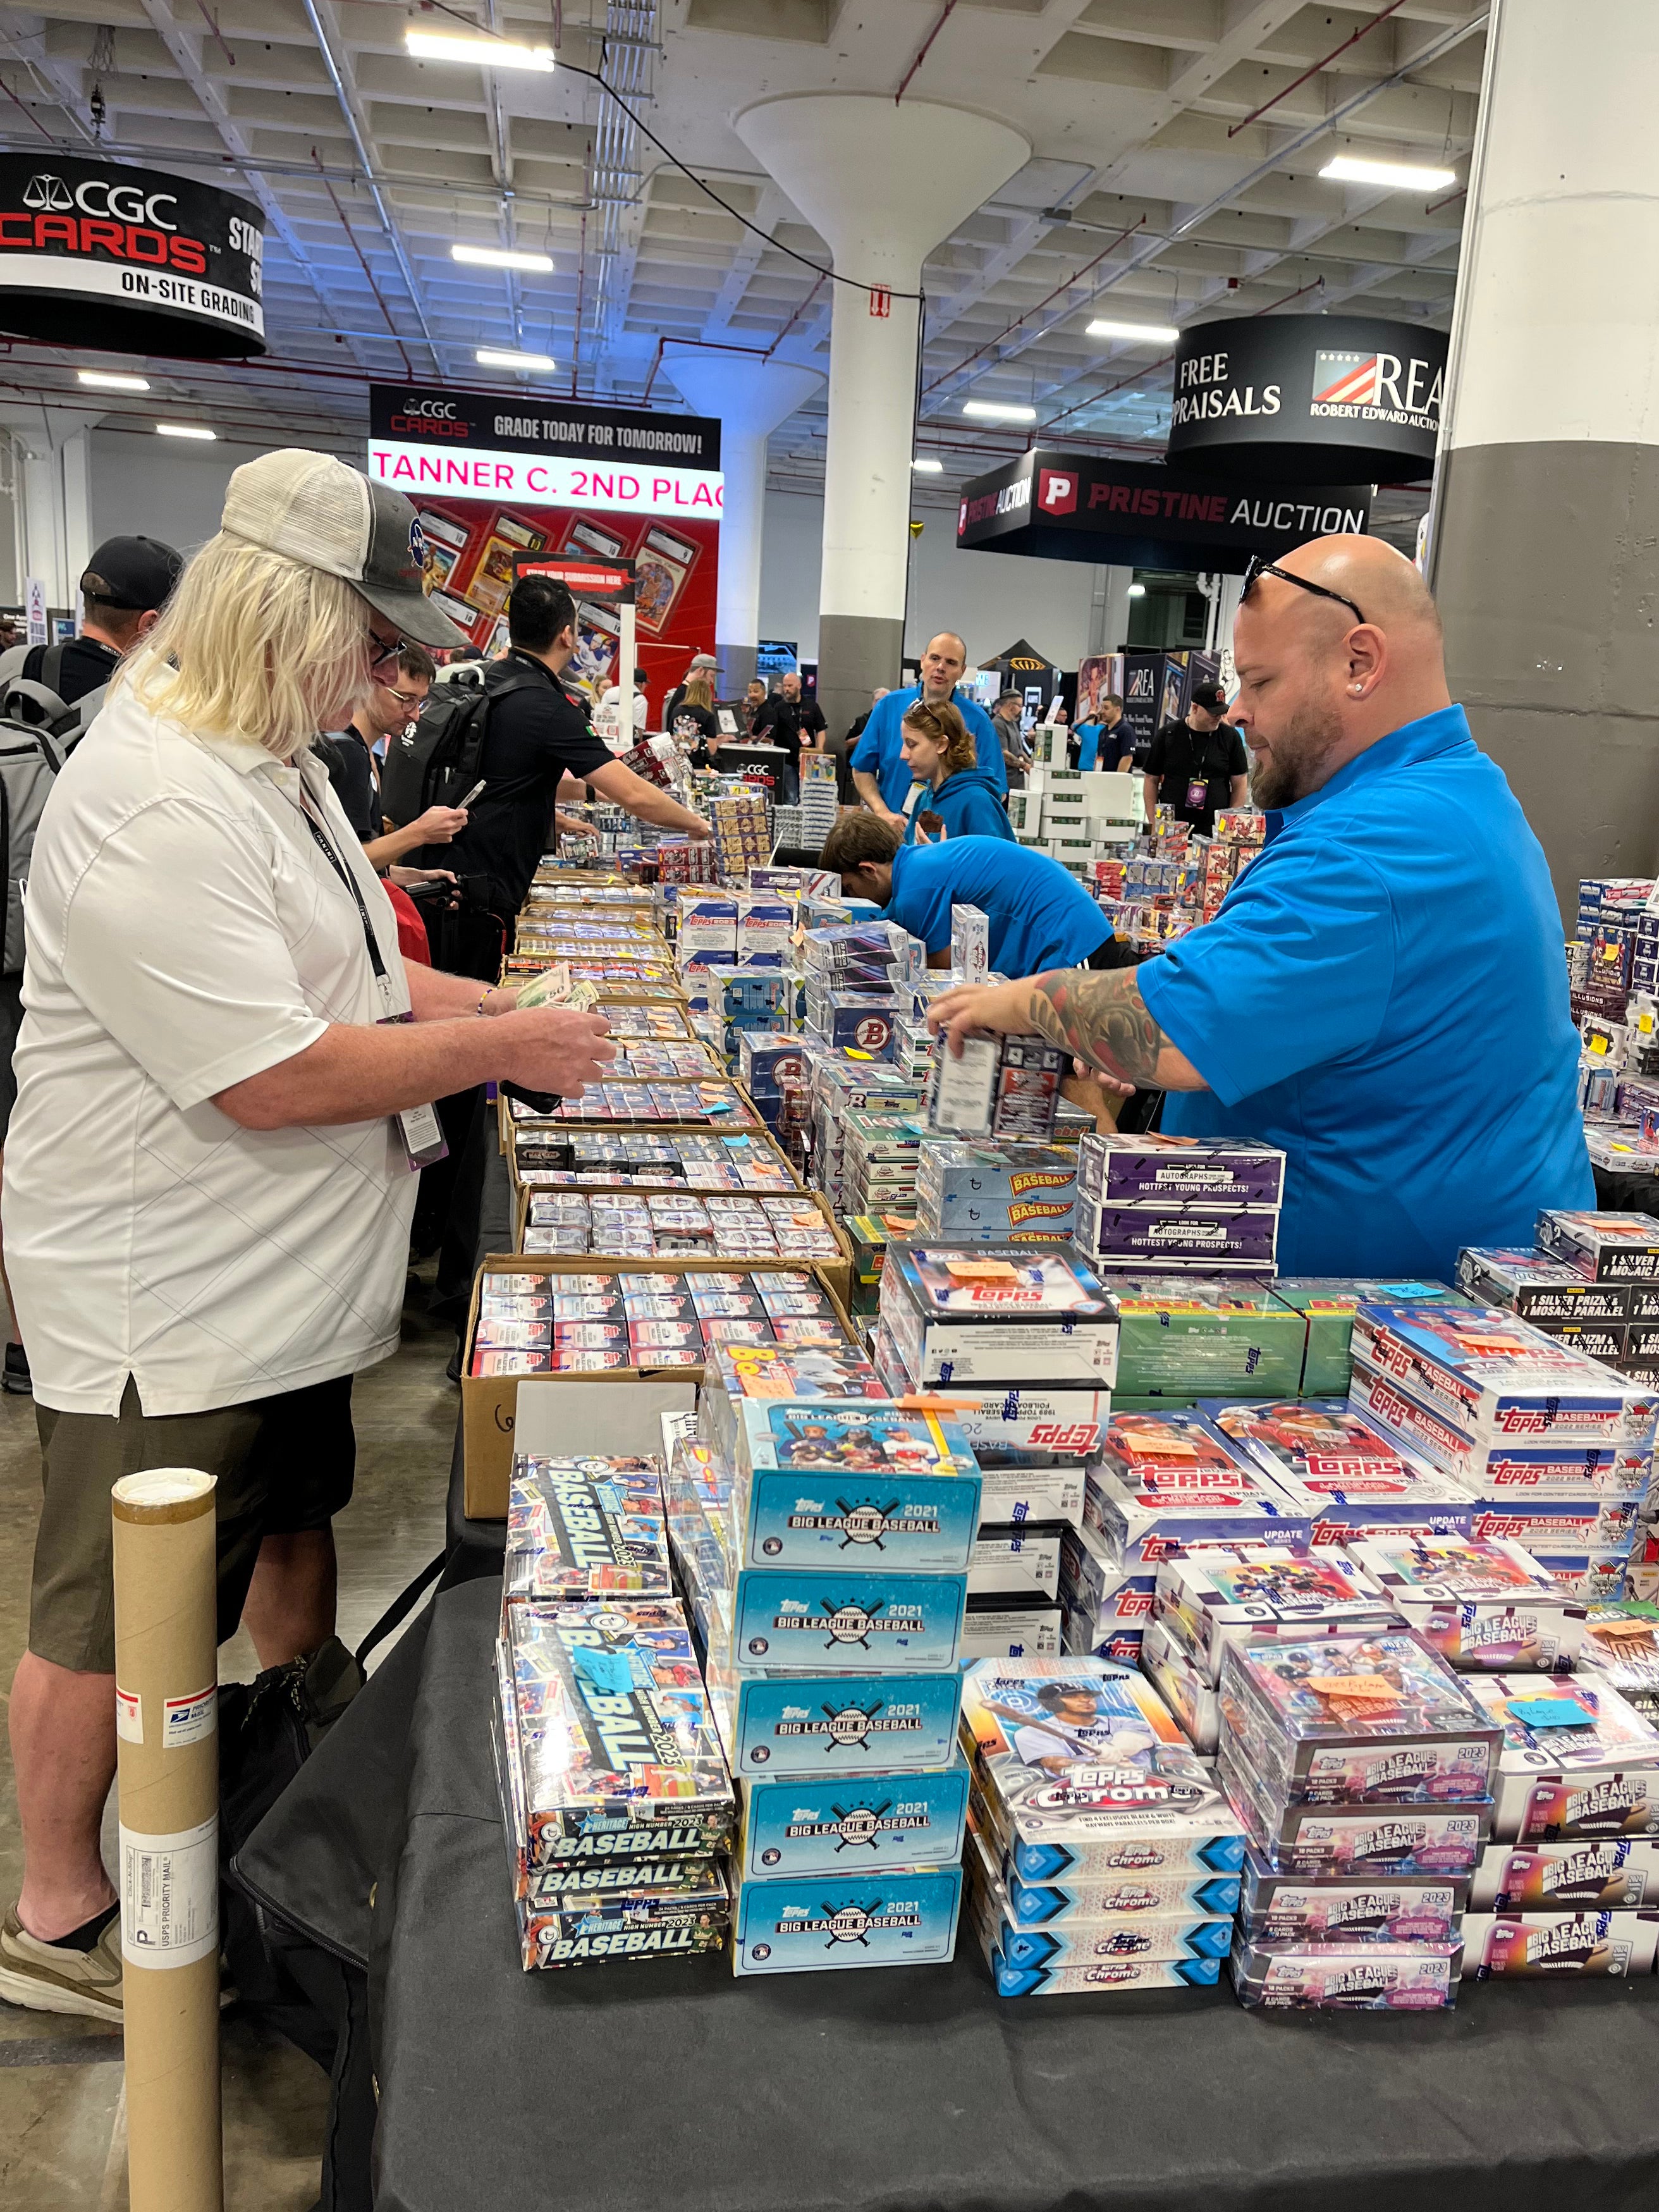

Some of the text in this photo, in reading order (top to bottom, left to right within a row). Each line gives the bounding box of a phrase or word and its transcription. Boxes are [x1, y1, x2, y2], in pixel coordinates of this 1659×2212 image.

[75, 180, 178, 231] CGC
[0, 212, 206, 274] CARDS
[122, 272, 254, 324] ON-SITE GRADING
[1180, 352, 1228, 389] FREE
[1373, 352, 1442, 415] REA
[420, 400, 457, 420] CGC
[1311, 403, 1361, 418] ROBERT
[1362, 407, 1409, 424] EDWARD
[390, 415, 469, 438] CARDS
[494, 415, 702, 455] GRADE TODAY FOR TOMORROW!
[372, 452, 514, 490] TANNER
[526, 467, 557, 494] C.
[570, 471, 640, 500] 2ND
[996, 476, 1031, 515] AUCTION
[1045, 477, 1364, 535] P PRISTINE AUCTION
[529, 537, 541, 551] 10
[565, 572, 605, 584] SUBMISSION
[606, 574, 621, 586] HERE
[464, 612, 473, 624] 10
[1137, 668, 1154, 696] REA
[747, 764, 769, 777] CGC
[314, 832, 336, 863] PANINI
[1572, 993, 1603, 1004] ILLUSIONS
[862, 1022, 884, 1045] B
[1013, 1176, 1070, 1191] BASEBALL
[1160, 1172, 1208, 1181] AUTOGRAPHS
[1139, 1182, 1249, 1193] HOTTEST YOUNG PROSPECTS!
[1012, 1205, 1068, 1221] BASEBALL
[1153, 1228, 1201, 1237] AUTOGRAPHS
[1132, 1238, 1242, 1250] HOTTEST YOUNG PROSPECTS!
[1619, 1255, 1653, 1265] SILVER
[1612, 1266, 1652, 1277] MOSAIC
[1531, 1295, 1574, 1306] 1 SILVER
[1522, 1306, 1624, 1317] 1 MOSAIC PARALLEL
[494, 1403, 515, 1434] 6
[1556, 1413, 1607, 1422] BASEBALL
[1414, 1412, 1459, 1451] BASEBALL
[1429, 1436, 1453, 1460] SERIES
[904, 1504, 938, 1517] 2021
[792, 1516, 940, 1532] BIG LEAGUE BASEBALL
[1429, 1516, 1466, 1525] UPDATE
[1530, 1517, 1582, 1527] BASEBALL
[1264, 1530, 1302, 1539] UPDATE
[889, 1604, 922, 1617] 2021
[778, 1617, 924, 1631] BIG LEAGUE BASEBALL
[1487, 1615, 1537, 1631] LEAGUE
[1467, 1629, 1529, 1646] BASEBALL
[888, 1704, 920, 1716] 2021
[779, 1719, 922, 1735] BIG LEAGUE BASEBALL
[651, 1733, 686, 1767] 2023
[1458, 1747, 1486, 1759] 2023
[1371, 1750, 1437, 1778] BIG LEAGUE
[1373, 1764, 1429, 1786] BASEBALL
[1571, 1779, 1647, 1806] BIG LEAGUE
[896, 1802, 928, 1815] 2021
[1574, 1795, 1639, 1818] BASEBALL
[592, 1819, 628, 1831] HERITAGE
[646, 1821, 672, 1829] NUMBER
[673, 1817, 703, 1828] 2023
[790, 1816, 930, 1837] BIG LEAGUE BASEBALL
[1447, 1820, 1476, 1832] 2023
[1359, 1822, 1426, 1844] BIG LEAGUE
[554, 1828, 701, 1858] BASEBALL
[1361, 1834, 1418, 1855] BASEBALL
[1109, 1855, 1163, 1867] Chrome
[1547, 1860, 1565, 1876] BIG
[542, 1862, 685, 1893] BASEBALL
[1550, 1862, 1614, 1888] BASEBALL
[1105, 1896, 1159, 1908] Chrome
[1351, 1893, 1400, 1910] LEAGUE
[1422, 1891, 1451, 1903] 2023
[886, 1902, 919, 1914] 2021
[1334, 1906, 1392, 1923] BASEBALL
[588, 1920, 623, 1932] HERITAGE
[666, 1918, 696, 1929] 2023
[780, 1915, 921, 1932] BIG LEAGUE BASEBALL
[137, 1929, 156, 1946] P
[551, 1927, 694, 1960] BASEBALL
[1531, 1930, 1550, 1945] BIG
[1534, 1932, 1601, 1959] BASEBALL
[1086, 1969, 1139, 1980] Chrome
[1347, 1964, 1398, 1981] LEAGUE
[1419, 1963, 1448, 1975] 2023
